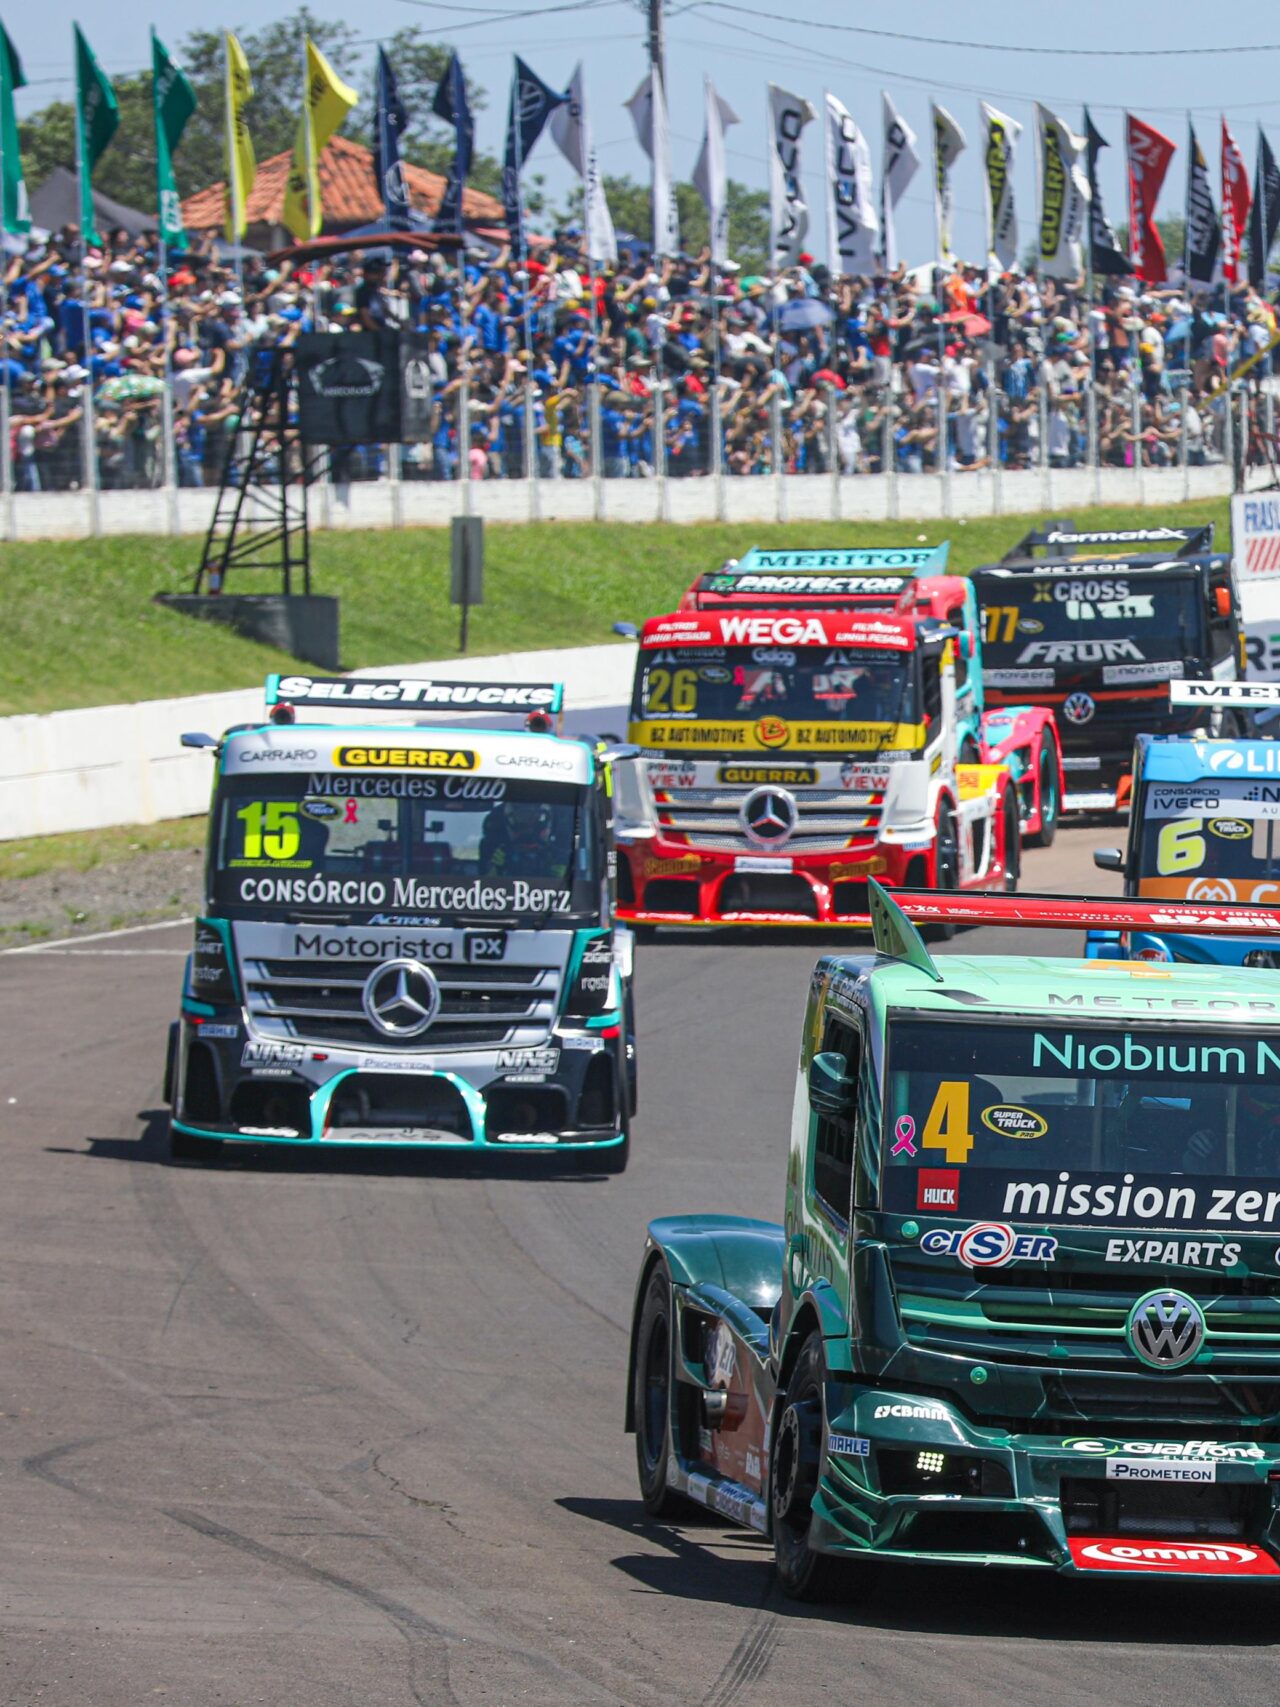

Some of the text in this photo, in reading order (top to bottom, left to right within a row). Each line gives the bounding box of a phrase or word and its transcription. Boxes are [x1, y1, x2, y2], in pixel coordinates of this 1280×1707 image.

[837, 114, 857, 257] IVECO
[1040, 124, 1066, 259] GUERRA
[1047, 528, 1188, 544] farmatex
[736, 577, 904, 590] PROTECTOR
[719, 616, 829, 645] WEGA
[984, 606, 1019, 643] 77
[1016, 639, 1147, 664] FRUM
[648, 668, 698, 713] 26
[650, 727, 746, 743] BZ AUTOMOTIVE
[796, 728, 896, 743] BZ AUTOMOTIVE
[239, 748, 319, 763] CARRARO
[344, 748, 470, 769] GUERRA
[495, 754, 575, 771] CARRARO
[647, 775, 696, 788] VIEW
[725, 768, 812, 783] GUERRA
[841, 776, 891, 789] VIEW
[306, 772, 507, 800] Mercedes Club
[1154, 787, 1221, 797] CONSÓRCIO
[1153, 798, 1220, 810] IVECO
[236, 800, 300, 860] 15
[1218, 825, 1246, 834] TRUCK
[1157, 817, 1207, 877] 6
[239, 872, 571, 914] CONSÓRCIO Mercedes-Benz
[1158, 908, 1275, 919] GOVERNO FEDERAL
[294, 933, 505, 961] Motorista px
[1046, 992, 1277, 1014] METEOR
[1033, 1032, 1246, 1074] Niobium
[921, 1080, 975, 1164] 4
[992, 1110, 1024, 1122] SUPER
[997, 1116, 1038, 1130] TRUCK
[1019, 1131, 1036, 1139] PRO
[922, 1187, 956, 1207] HUCK
[1002, 1173, 1196, 1218] mission
[920, 1223, 1058, 1267] CISER
[1105, 1238, 1243, 1267] EXPARTS
[828, 1436, 869, 1455] MAHLE
[1122, 1440, 1266, 1459] Giaffone
[1163, 1455, 1236, 1463] ELECTRIC
[1111, 1464, 1212, 1481] PROMETEON
[1110, 1546, 1230, 1562] omni
